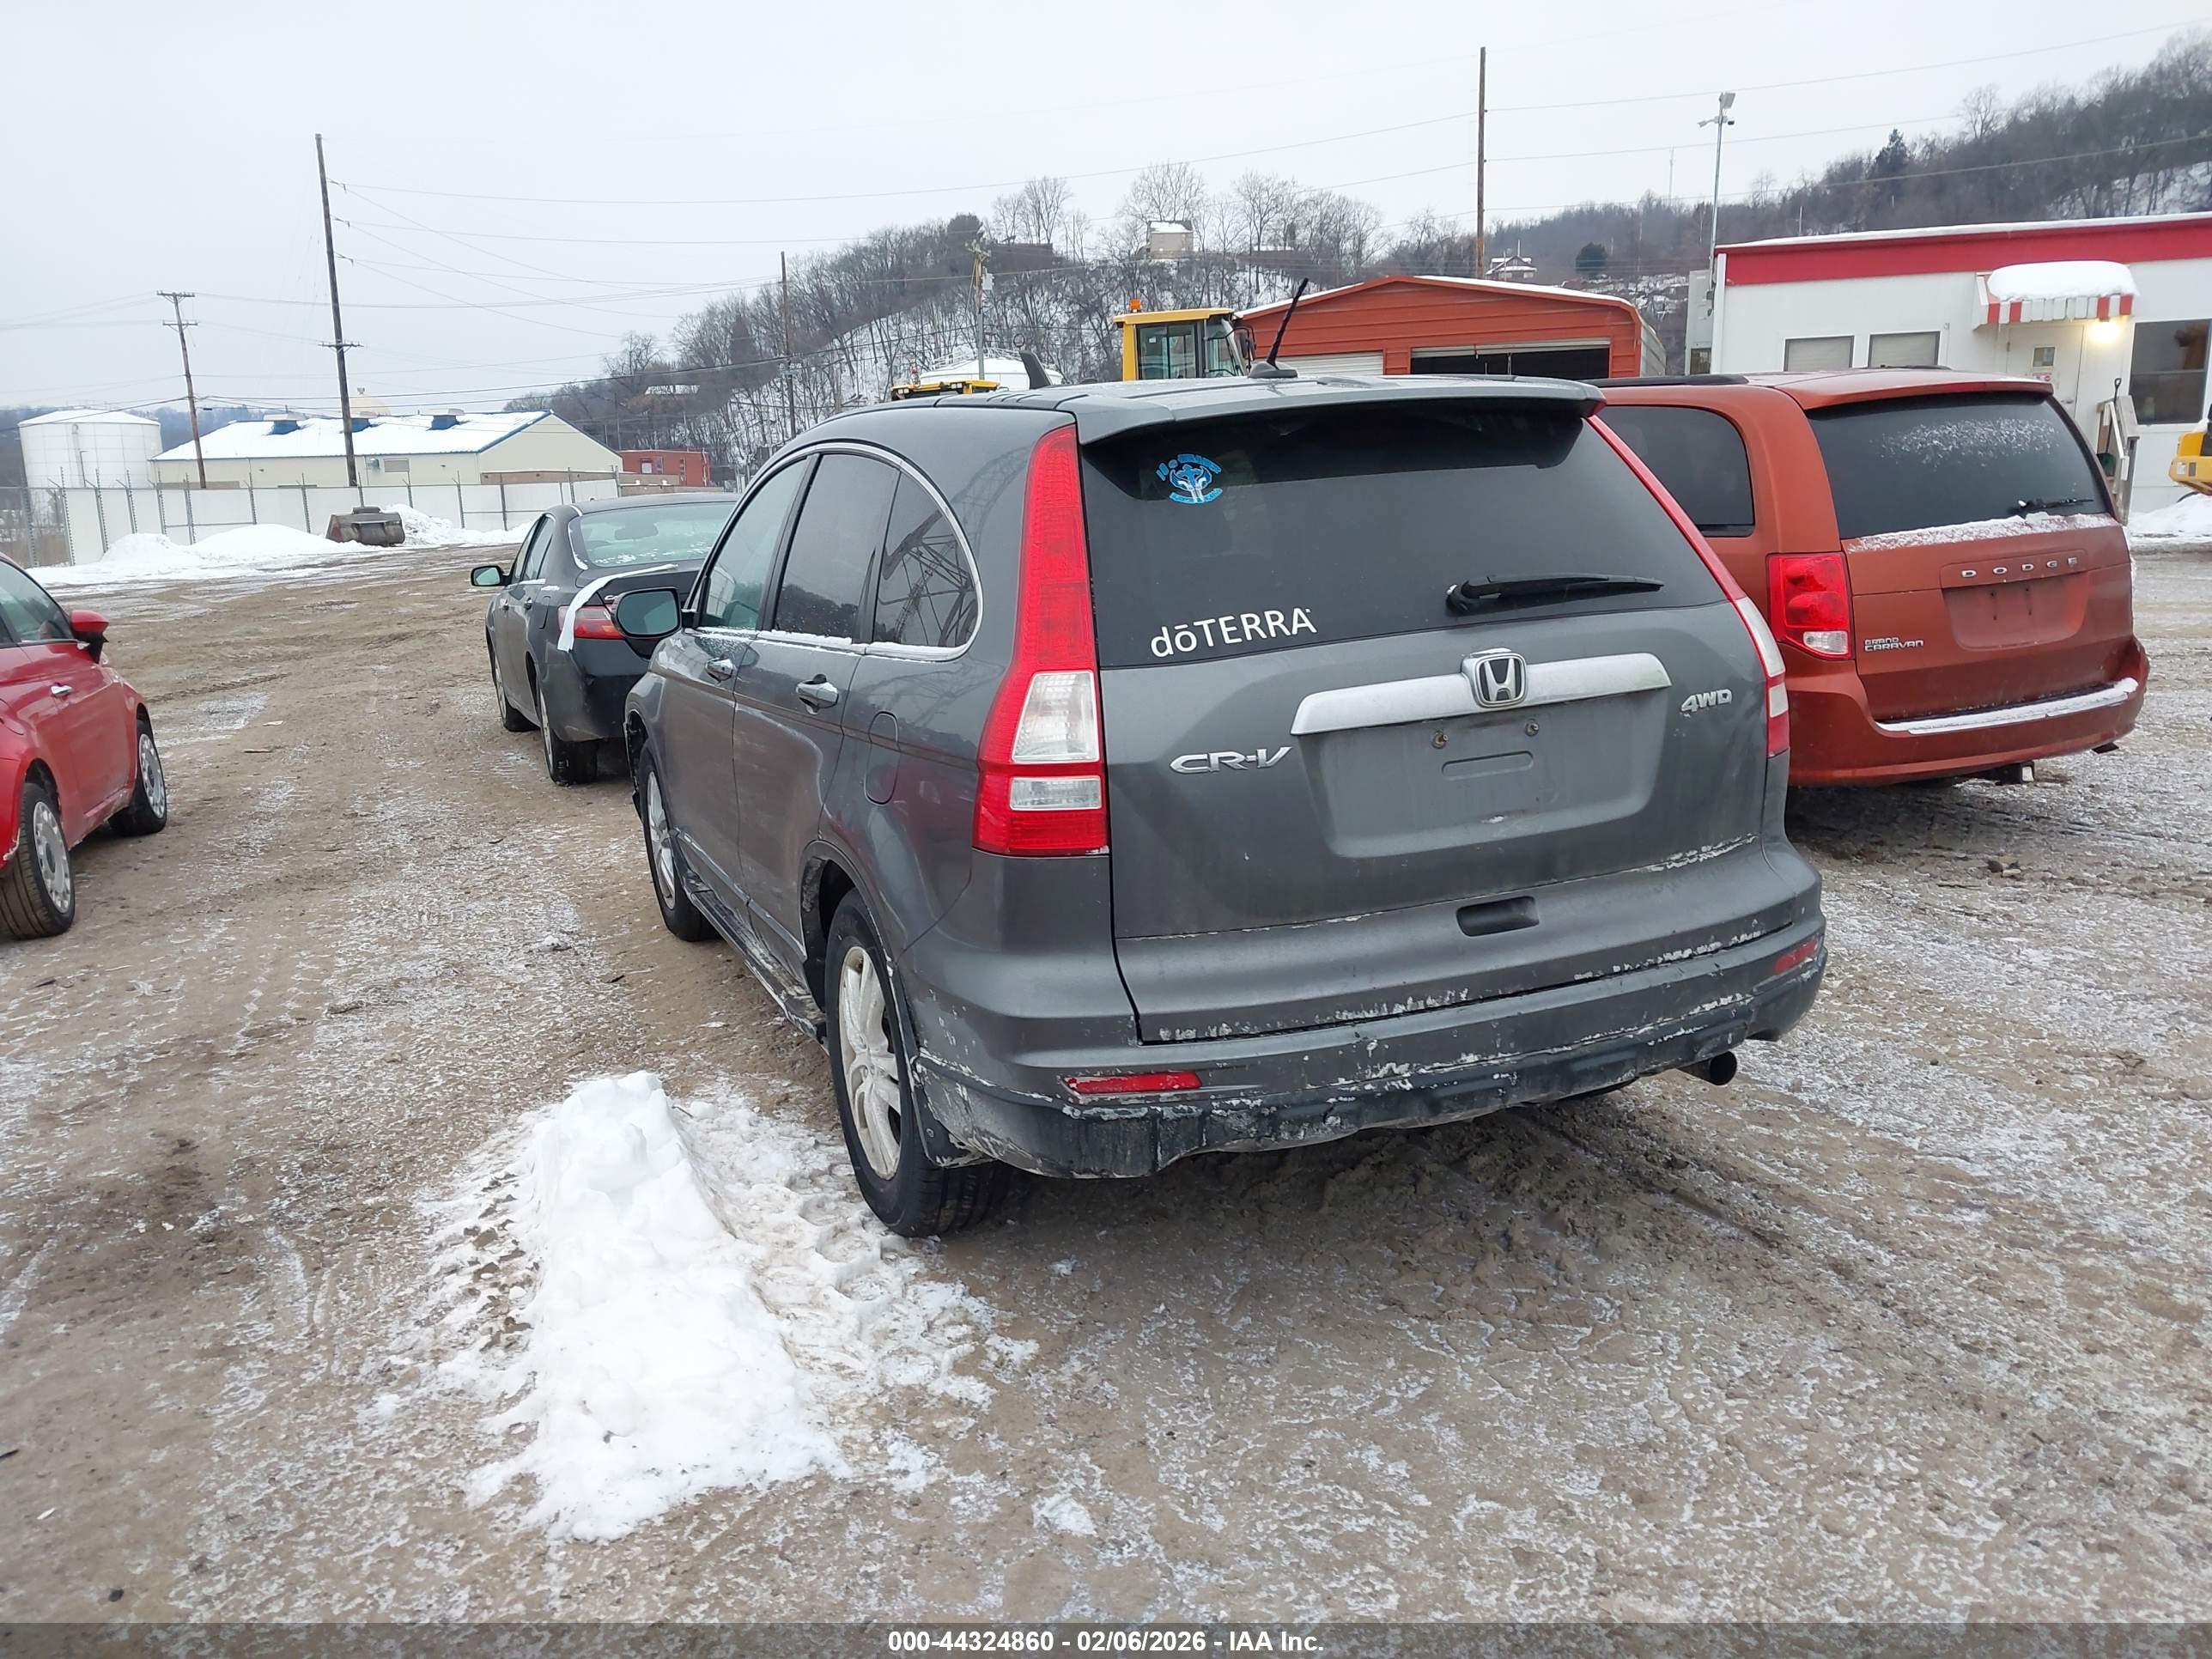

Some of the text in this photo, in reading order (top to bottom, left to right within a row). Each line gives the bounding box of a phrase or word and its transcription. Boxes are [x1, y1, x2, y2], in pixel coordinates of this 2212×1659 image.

[1960, 556, 2078, 578] DODGE
[1864, 636, 1899, 646] GRAND
[1864, 640, 1924, 652] CARAVAN
[1680, 689, 1733, 713] 4WD
[1170, 746, 1292, 774] CR-V
